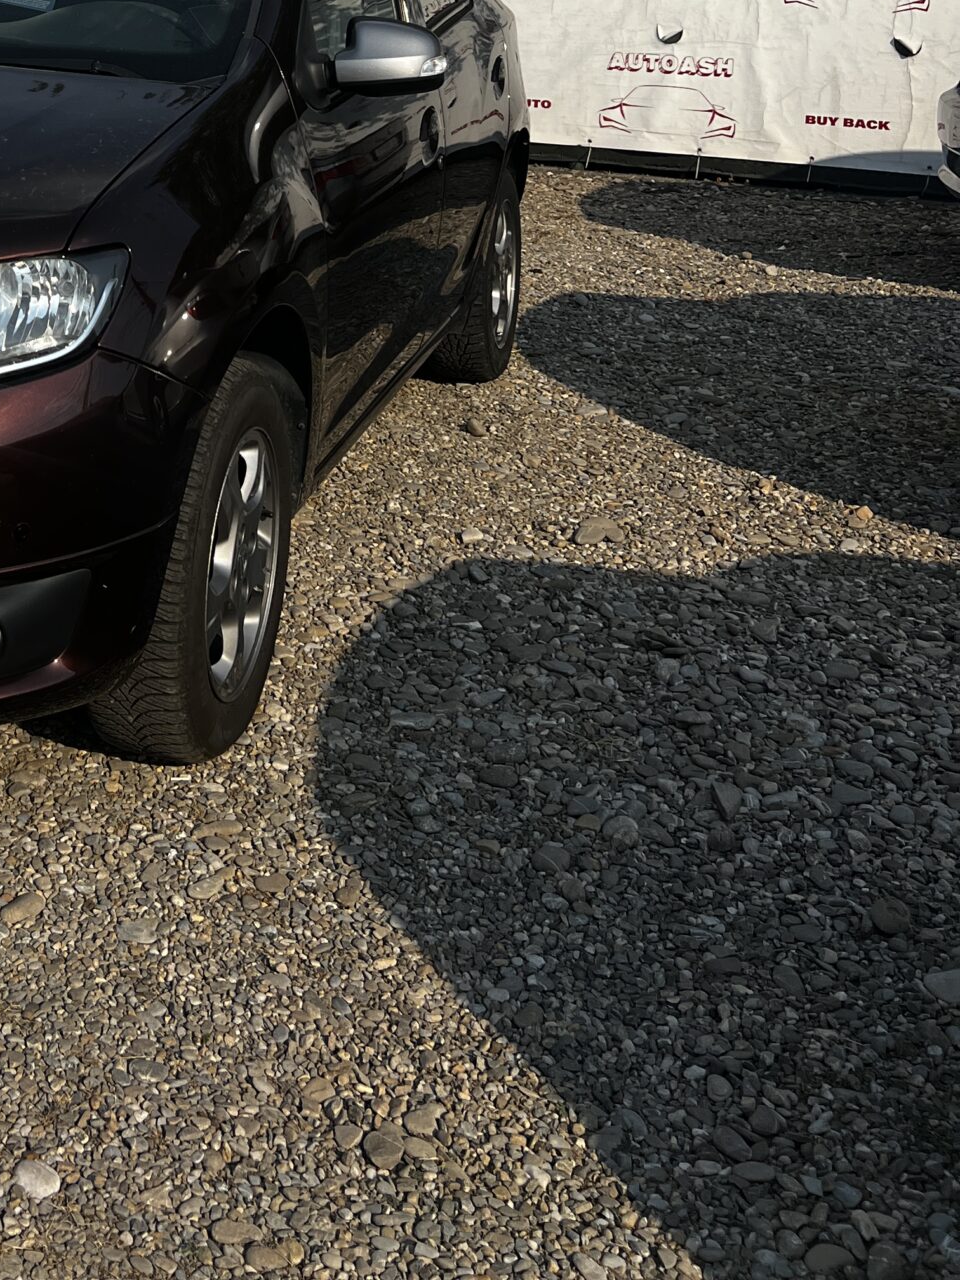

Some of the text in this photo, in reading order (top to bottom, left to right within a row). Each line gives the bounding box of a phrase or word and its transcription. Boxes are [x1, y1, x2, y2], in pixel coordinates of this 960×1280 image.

[608, 51, 734, 77] AUTOASH
[804, 114, 891, 131] BUY BACK
